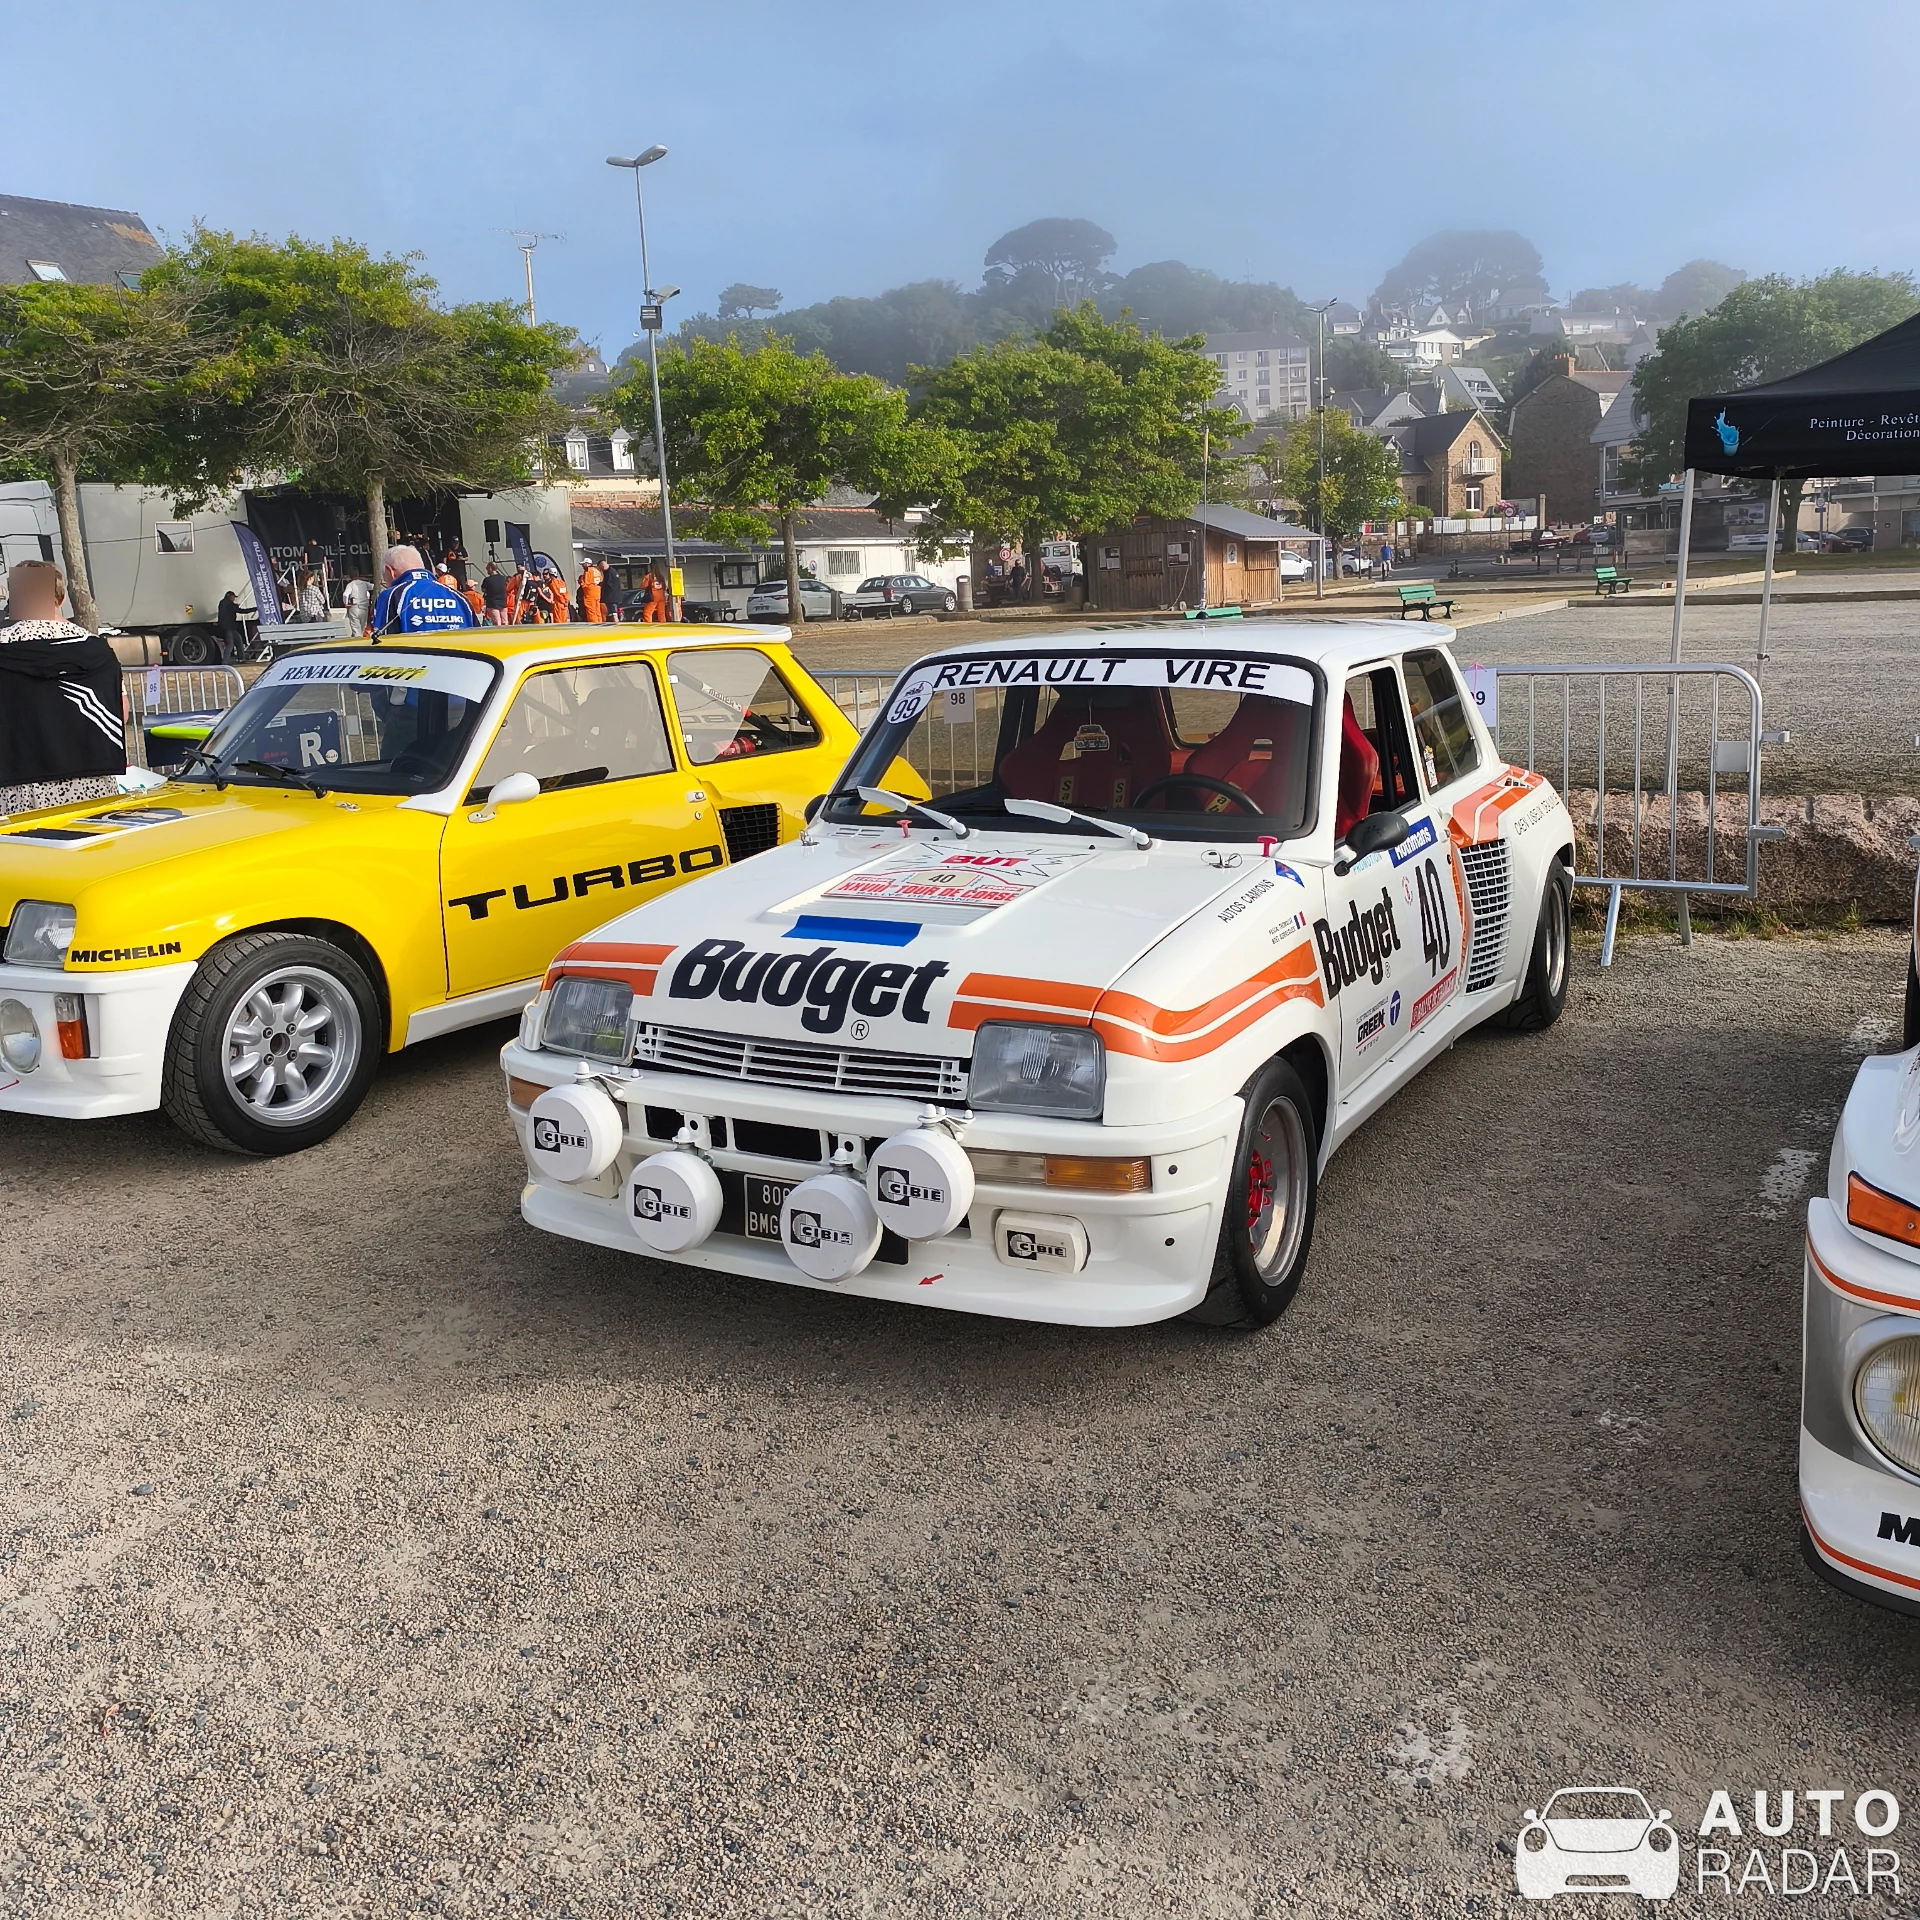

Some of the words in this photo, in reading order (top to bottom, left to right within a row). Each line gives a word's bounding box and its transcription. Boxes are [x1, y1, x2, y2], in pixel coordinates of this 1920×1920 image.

[1809, 417, 1865, 429] Peinture
[410, 597, 457, 612] tyco
[424, 615, 465, 624] SUZUKI
[279, 664, 362, 682] RENAULT
[933, 659, 1127, 687] RENAULT
[1166, 660, 1271, 690] VIRE
[890, 696, 921, 722] 99
[950, 692, 966, 705] 98
[1470, 690, 1486, 706] 9
[940, 854, 1030, 867] BUT
[447, 844, 724, 921] TURBO
[928, 874, 957, 884] 40
[895, 885, 941, 896] TOUR
[938, 887, 965, 898] DE
[959, 889, 1020, 902] CORSE
[1217, 901, 1247, 923] AUTOS
[1414, 857, 1451, 978] 40
[71, 941, 182, 963] MICHELIN
[1312, 886, 1402, 1001] Budget
[668, 938, 950, 1034] Budget
[1357, 1008, 1386, 1044] GREEN
[749, 1211, 779, 1235] BMG
